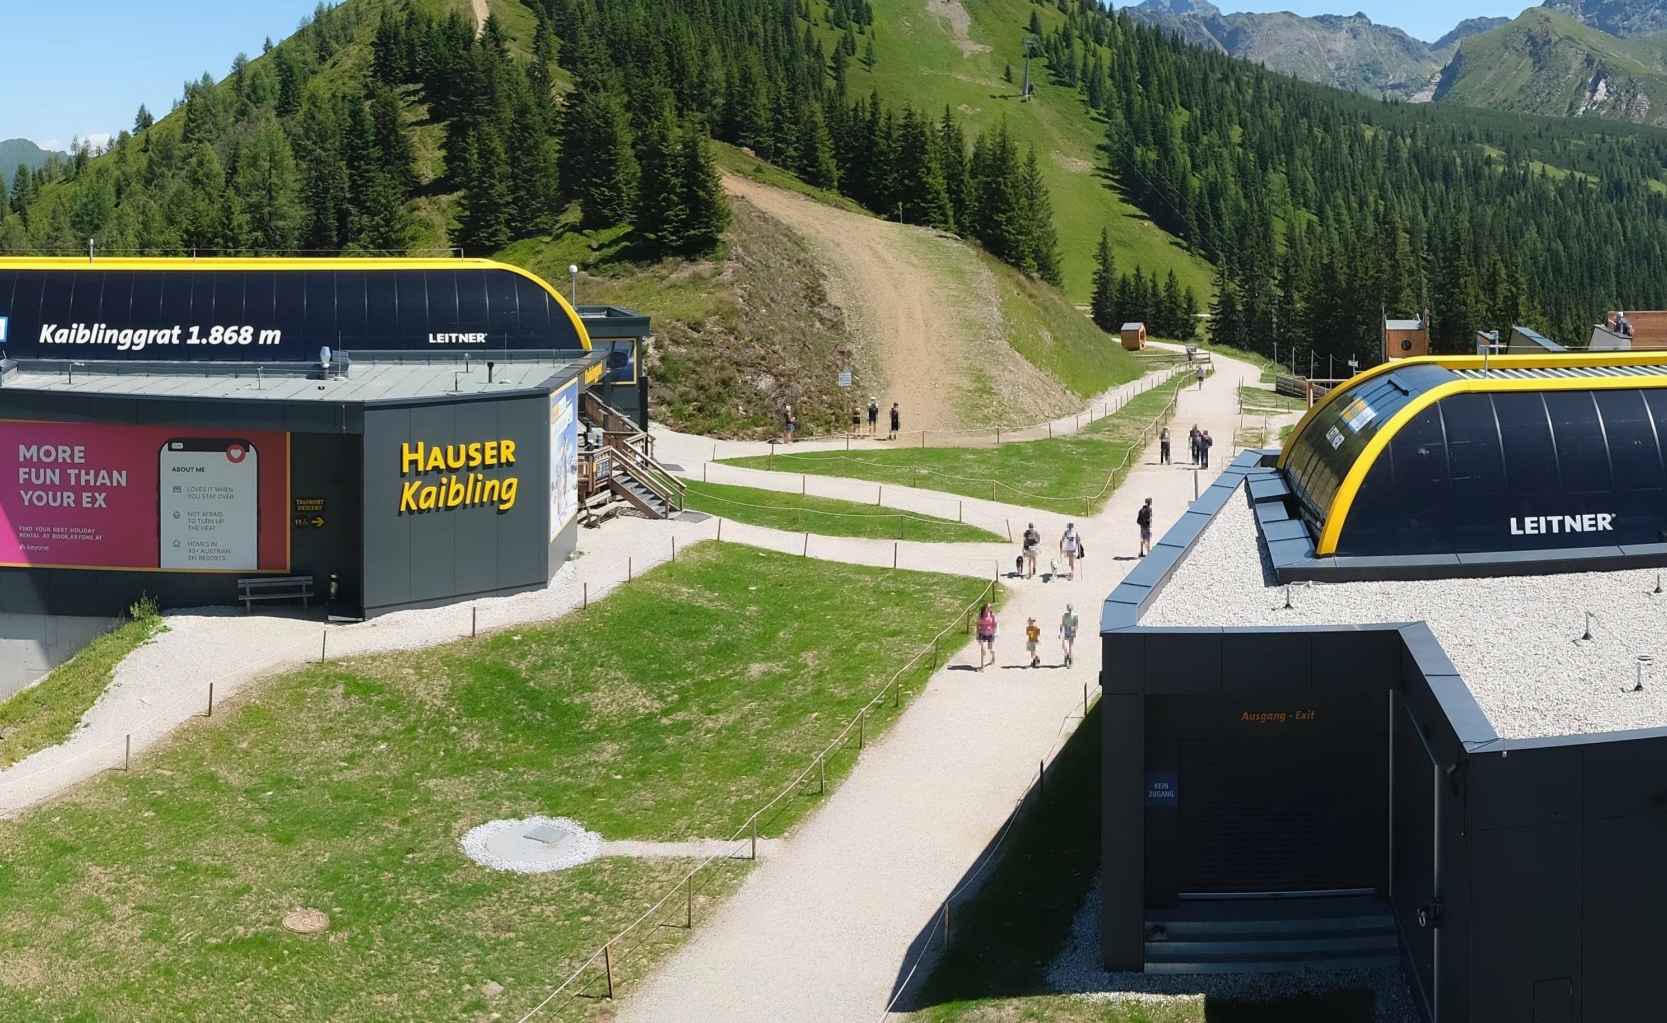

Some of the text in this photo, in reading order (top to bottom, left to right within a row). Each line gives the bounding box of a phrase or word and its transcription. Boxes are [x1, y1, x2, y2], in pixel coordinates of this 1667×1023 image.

[39, 323, 281, 350] Kaiblinggrat 1.868 m
[428, 333, 487, 344] LEITNER
[19, 444, 85, 463] MORE
[402, 440, 516, 473] HAUSER
[19, 468, 127, 487] FUN THAN
[20, 490, 107, 508] YOUR EX
[400, 474, 518, 511] Kaibling
[1510, 513, 1613, 535] LEITNER
[1240, 711, 1287, 723] Ausgang
[1295, 710, 1315, 720] Exit
